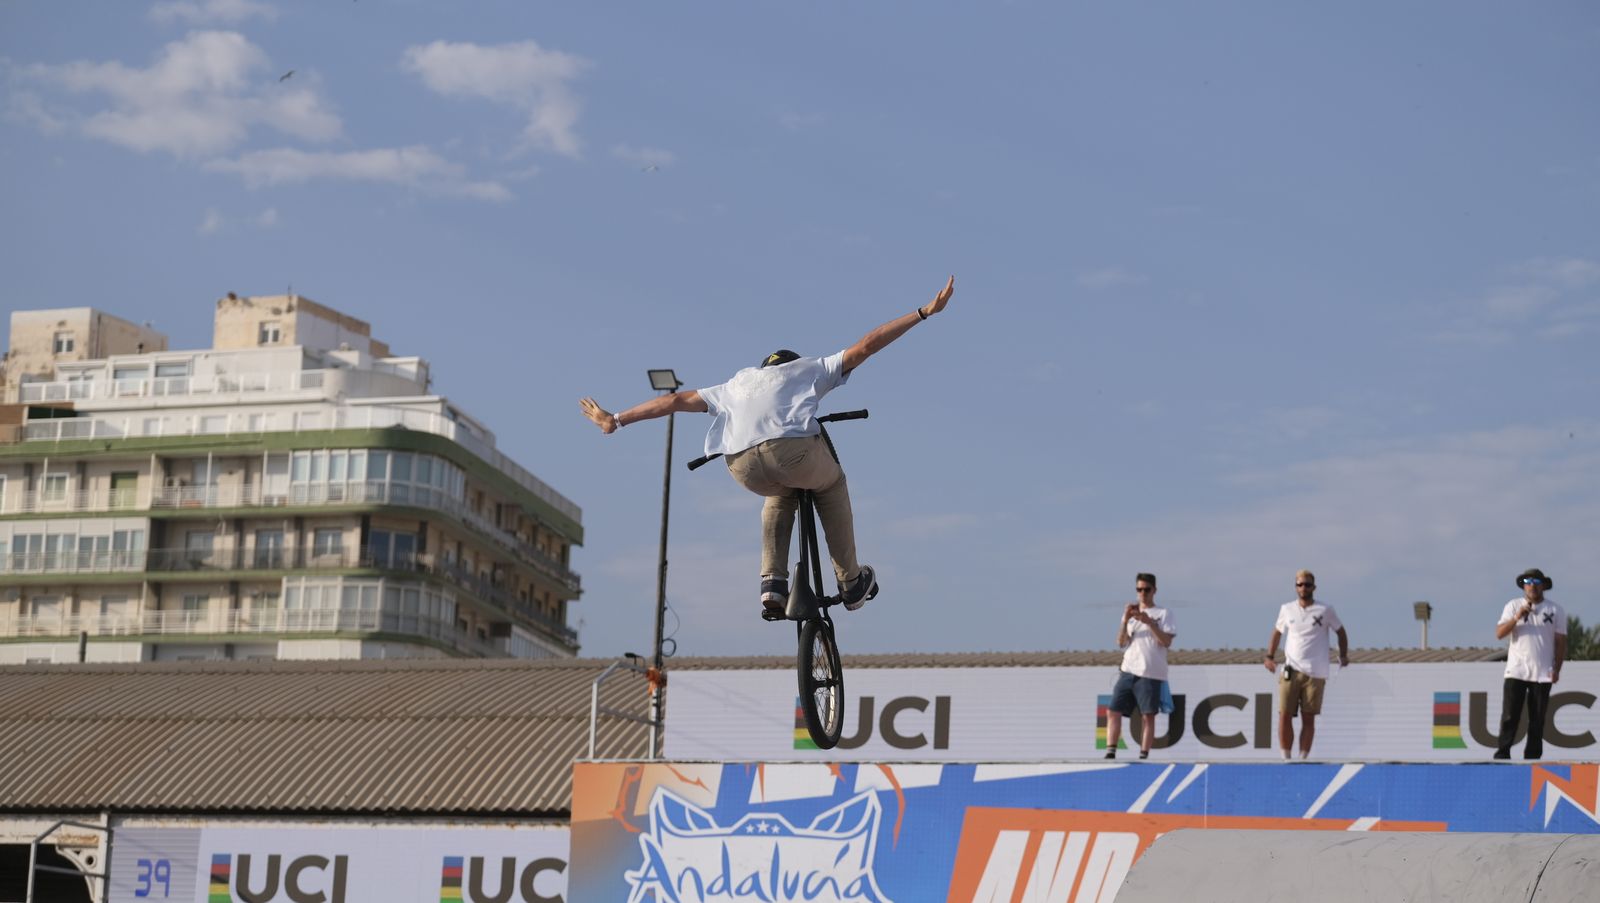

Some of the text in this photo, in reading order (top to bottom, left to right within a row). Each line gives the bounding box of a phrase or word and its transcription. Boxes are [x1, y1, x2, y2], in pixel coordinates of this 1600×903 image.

[823, 696, 951, 750] UCI
[1130, 692, 1272, 749] UCI
[135, 859, 171, 898] 39
[235, 854, 348, 903] UCI
